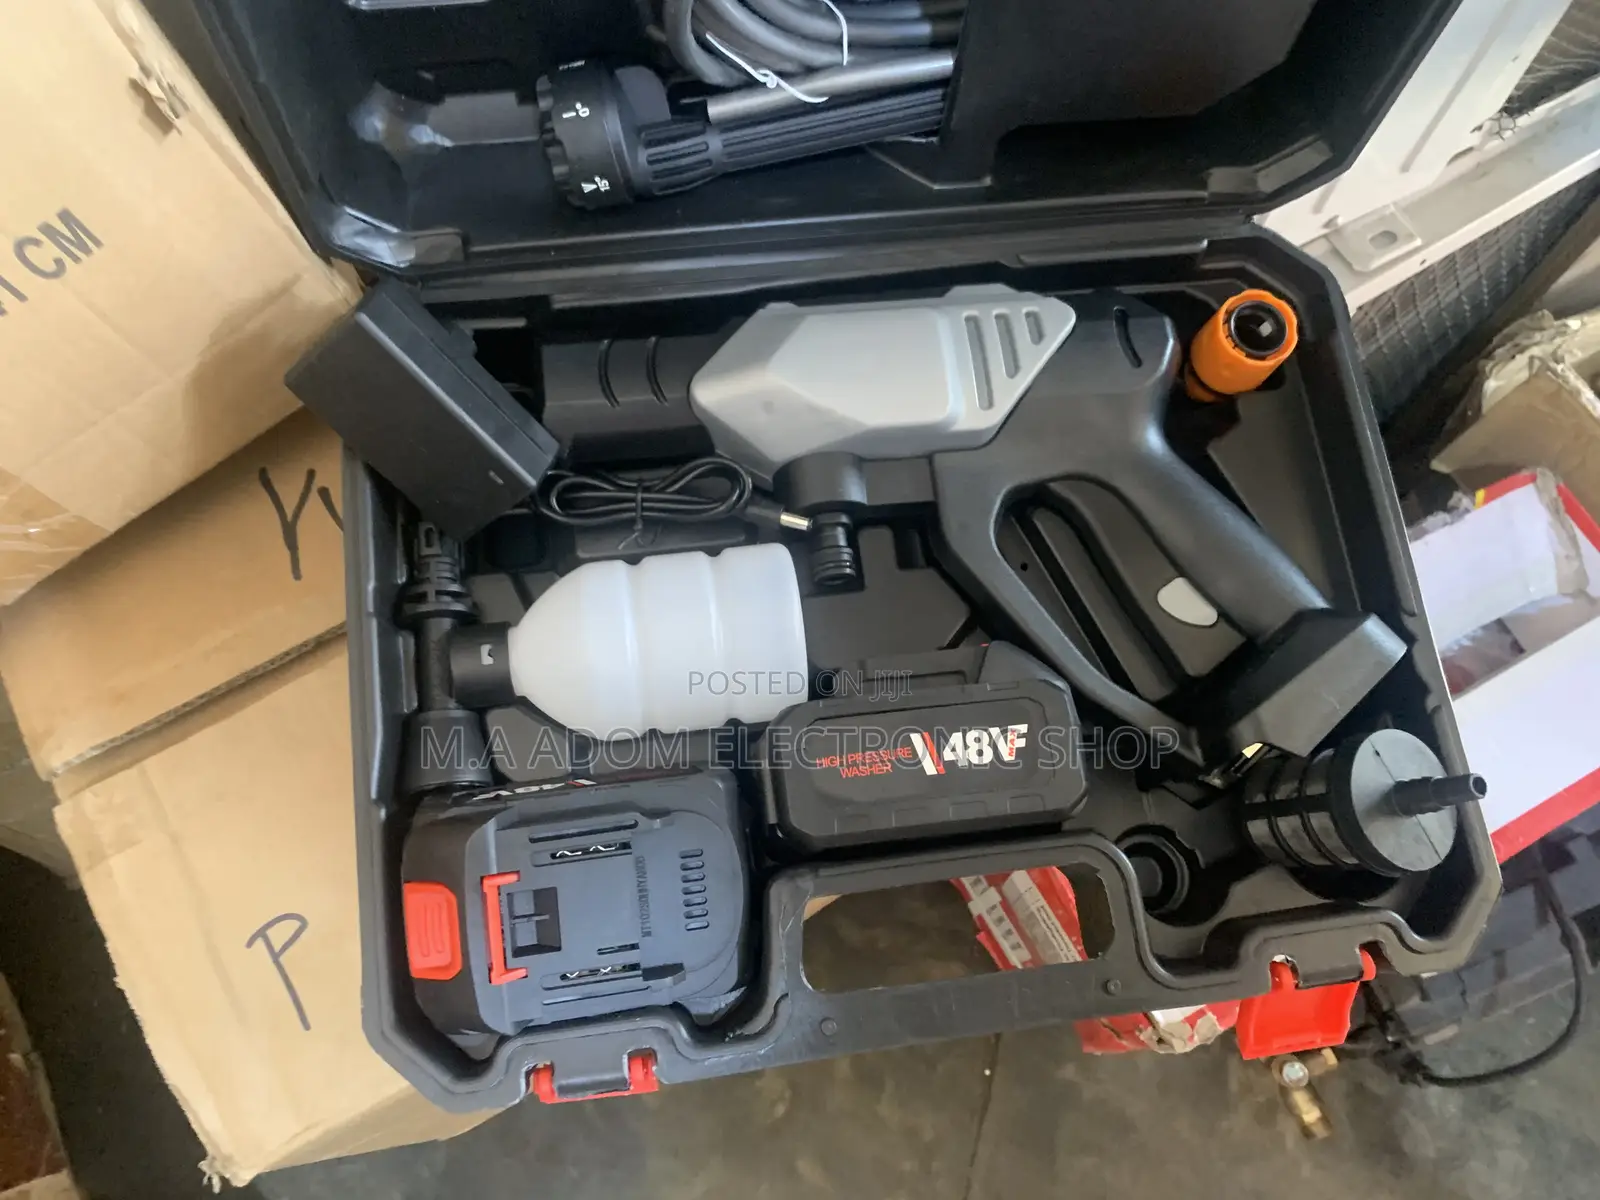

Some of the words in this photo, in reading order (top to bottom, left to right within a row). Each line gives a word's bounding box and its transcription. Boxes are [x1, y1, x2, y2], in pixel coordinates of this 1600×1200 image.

[13, 207, 104, 281] CM
[815, 755, 846, 769] HIGH
[847, 746, 913, 765] PRESSURE
[840, 761, 893, 779] WASHER
[245, 912, 312, 1031] P
